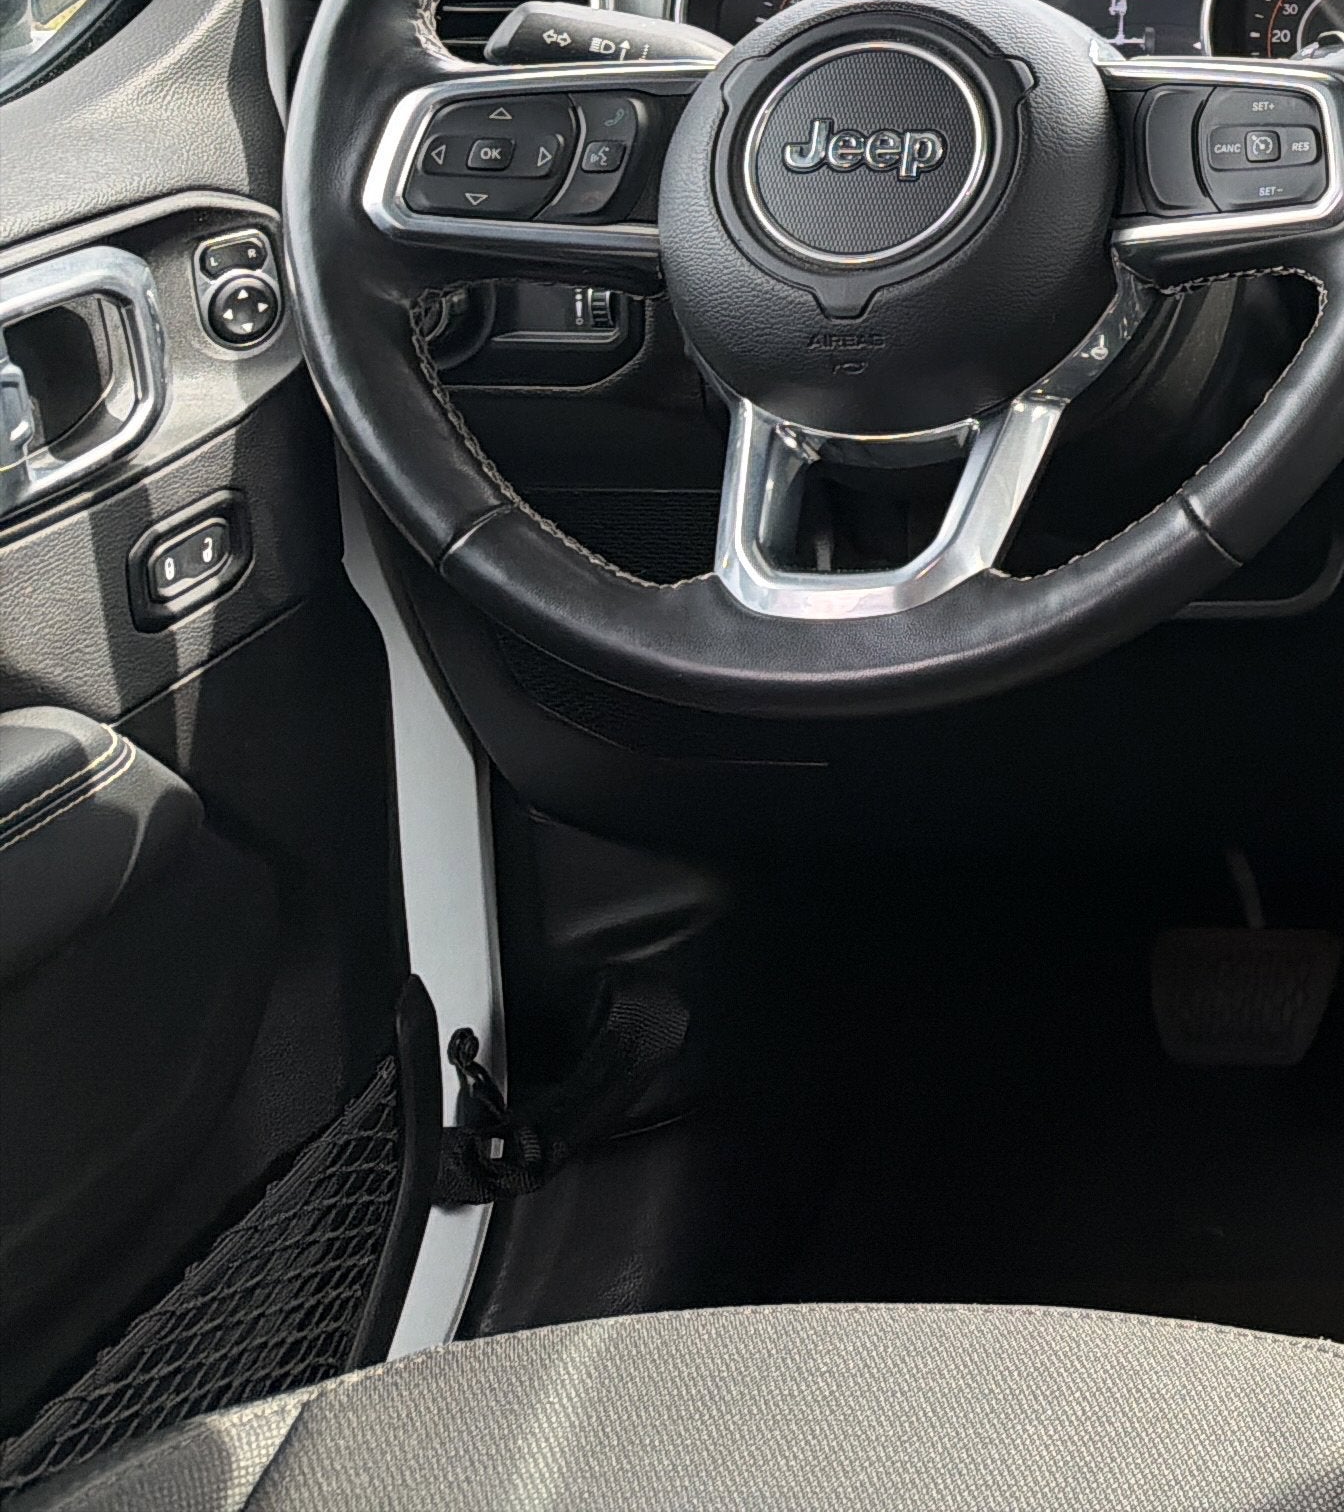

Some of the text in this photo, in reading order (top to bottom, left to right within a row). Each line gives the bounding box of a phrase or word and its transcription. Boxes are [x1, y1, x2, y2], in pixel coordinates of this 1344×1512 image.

[1282, 3, 1299, 15] 30
[1272, 29, 1291, 43] 20
[783, 118, 948, 181] Jeep
[1214, 143, 1241, 154] CANC
[1291, 141, 1310, 152] RES
[480, 147, 501, 160] OK
[247, 248, 257, 259] R
[210, 256, 219, 266] L
